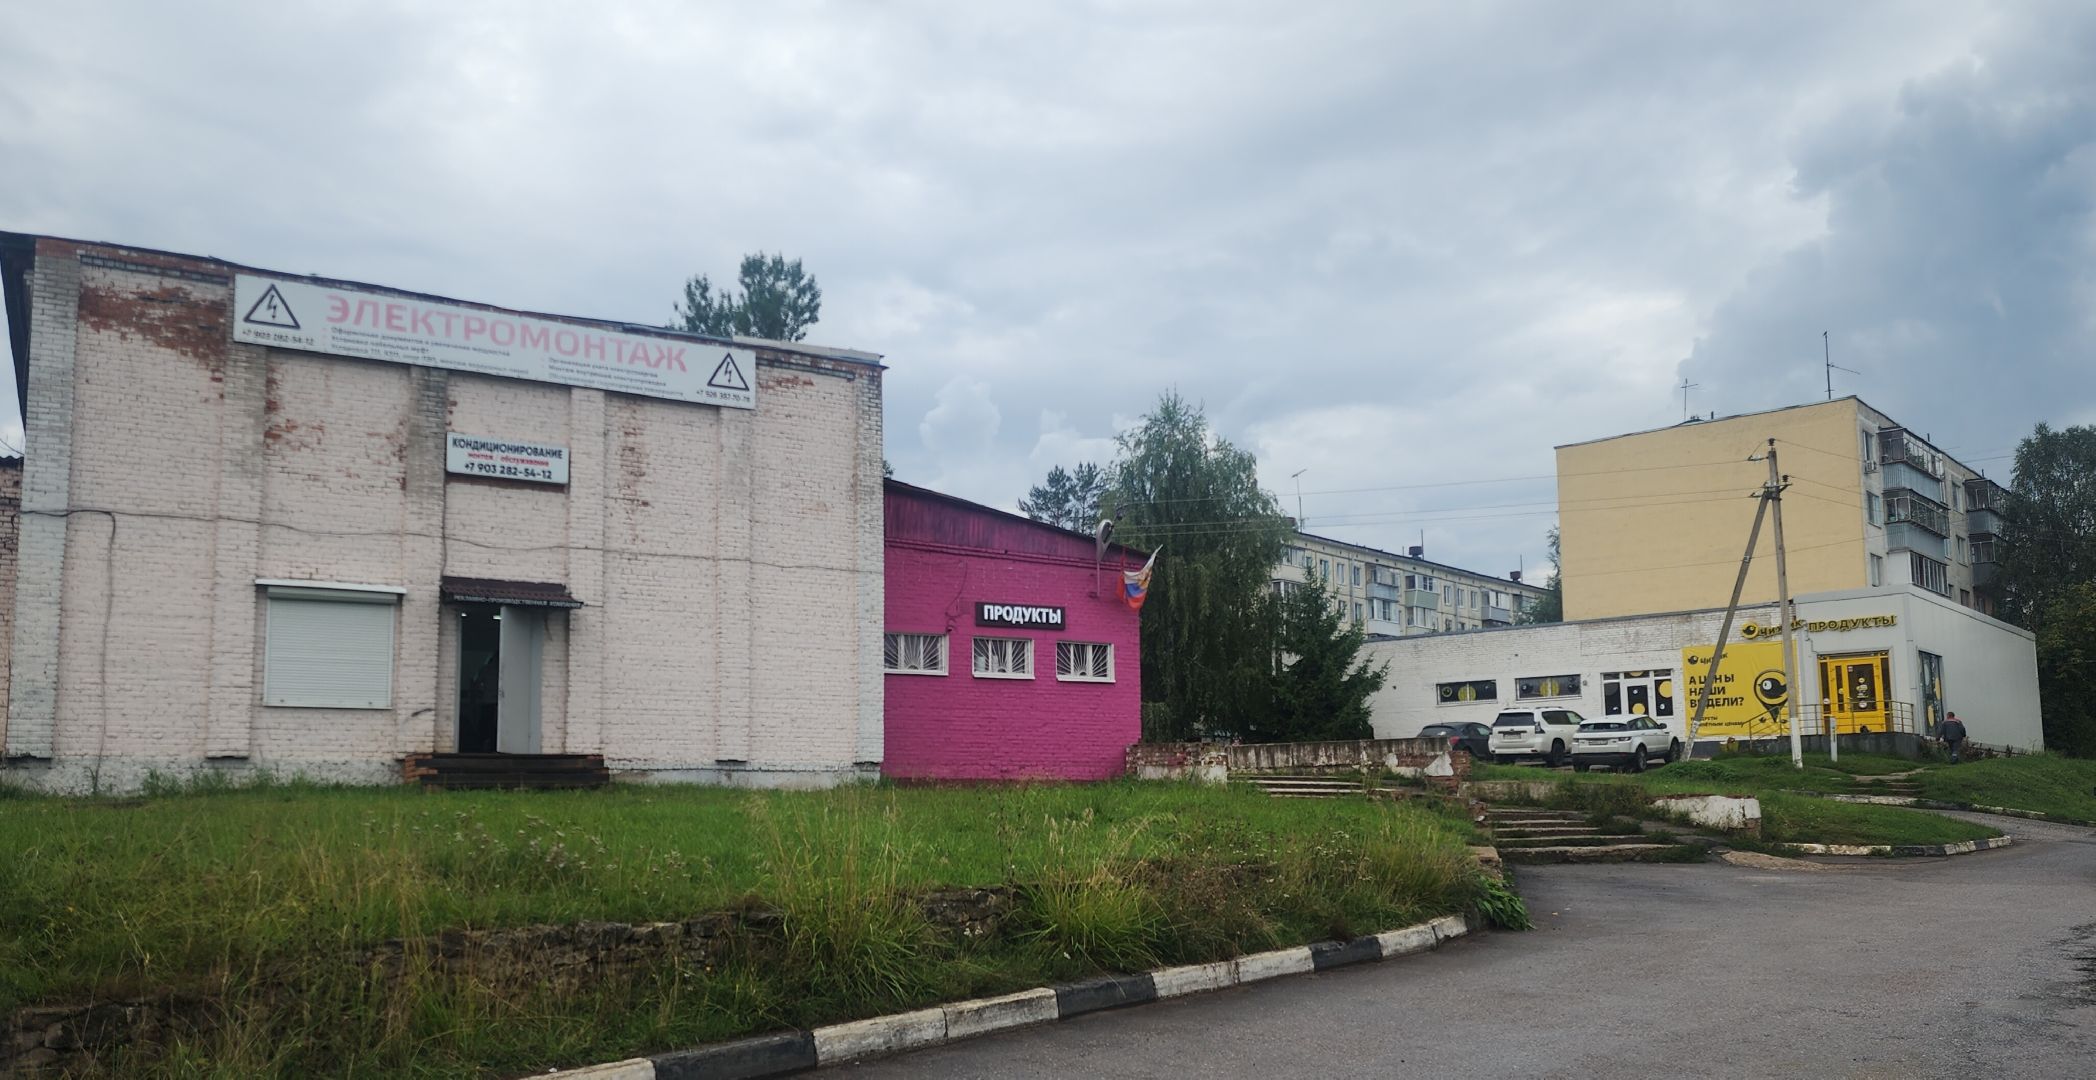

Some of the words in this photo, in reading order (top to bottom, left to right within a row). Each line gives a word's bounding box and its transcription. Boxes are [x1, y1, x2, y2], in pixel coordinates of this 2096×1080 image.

[326, 294, 688, 373] ЭЛЕКТРОМОНТАЖ
[452, 438, 562, 459] КОНДИЦИОНИРОВАНИЕ
[465, 463, 474, 471] +7
[477, 463, 497, 474] 903
[500, 466, 552, 480] 282-54-12
[984, 605, 1061, 624] ПРОДУКТЫ
[1808, 615, 1897, 633] ПРОДУКТЫ
[1689, 676, 1697, 685] А
[1699, 674, 1734, 685] ЦНЫ
[1690, 697, 1744, 710] ВДЕЛИ?
